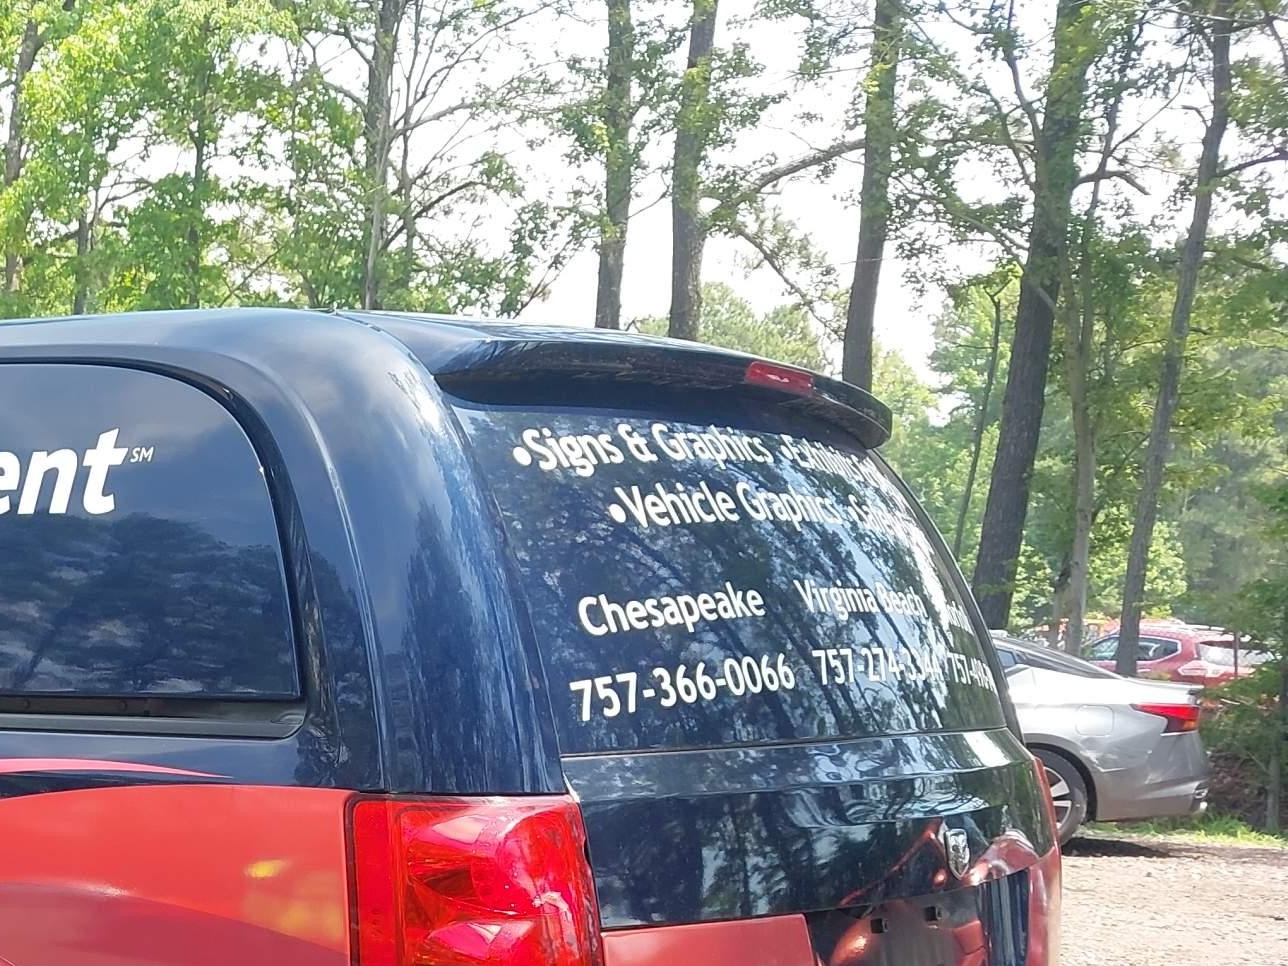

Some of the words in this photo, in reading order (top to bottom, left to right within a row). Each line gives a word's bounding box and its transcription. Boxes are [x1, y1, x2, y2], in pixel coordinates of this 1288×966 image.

[130, 446, 155, 463] SM
[617, 423, 658, 462] &
[651, 423, 774, 470] Graphics
[735, 481, 843, 532] Graphics
[578, 581, 766, 636] Chesapeake
[793, 580, 880, 621] Virginia
[875, 582, 929, 618] Beach
[570, 653, 796, 721] 757-366-0066
